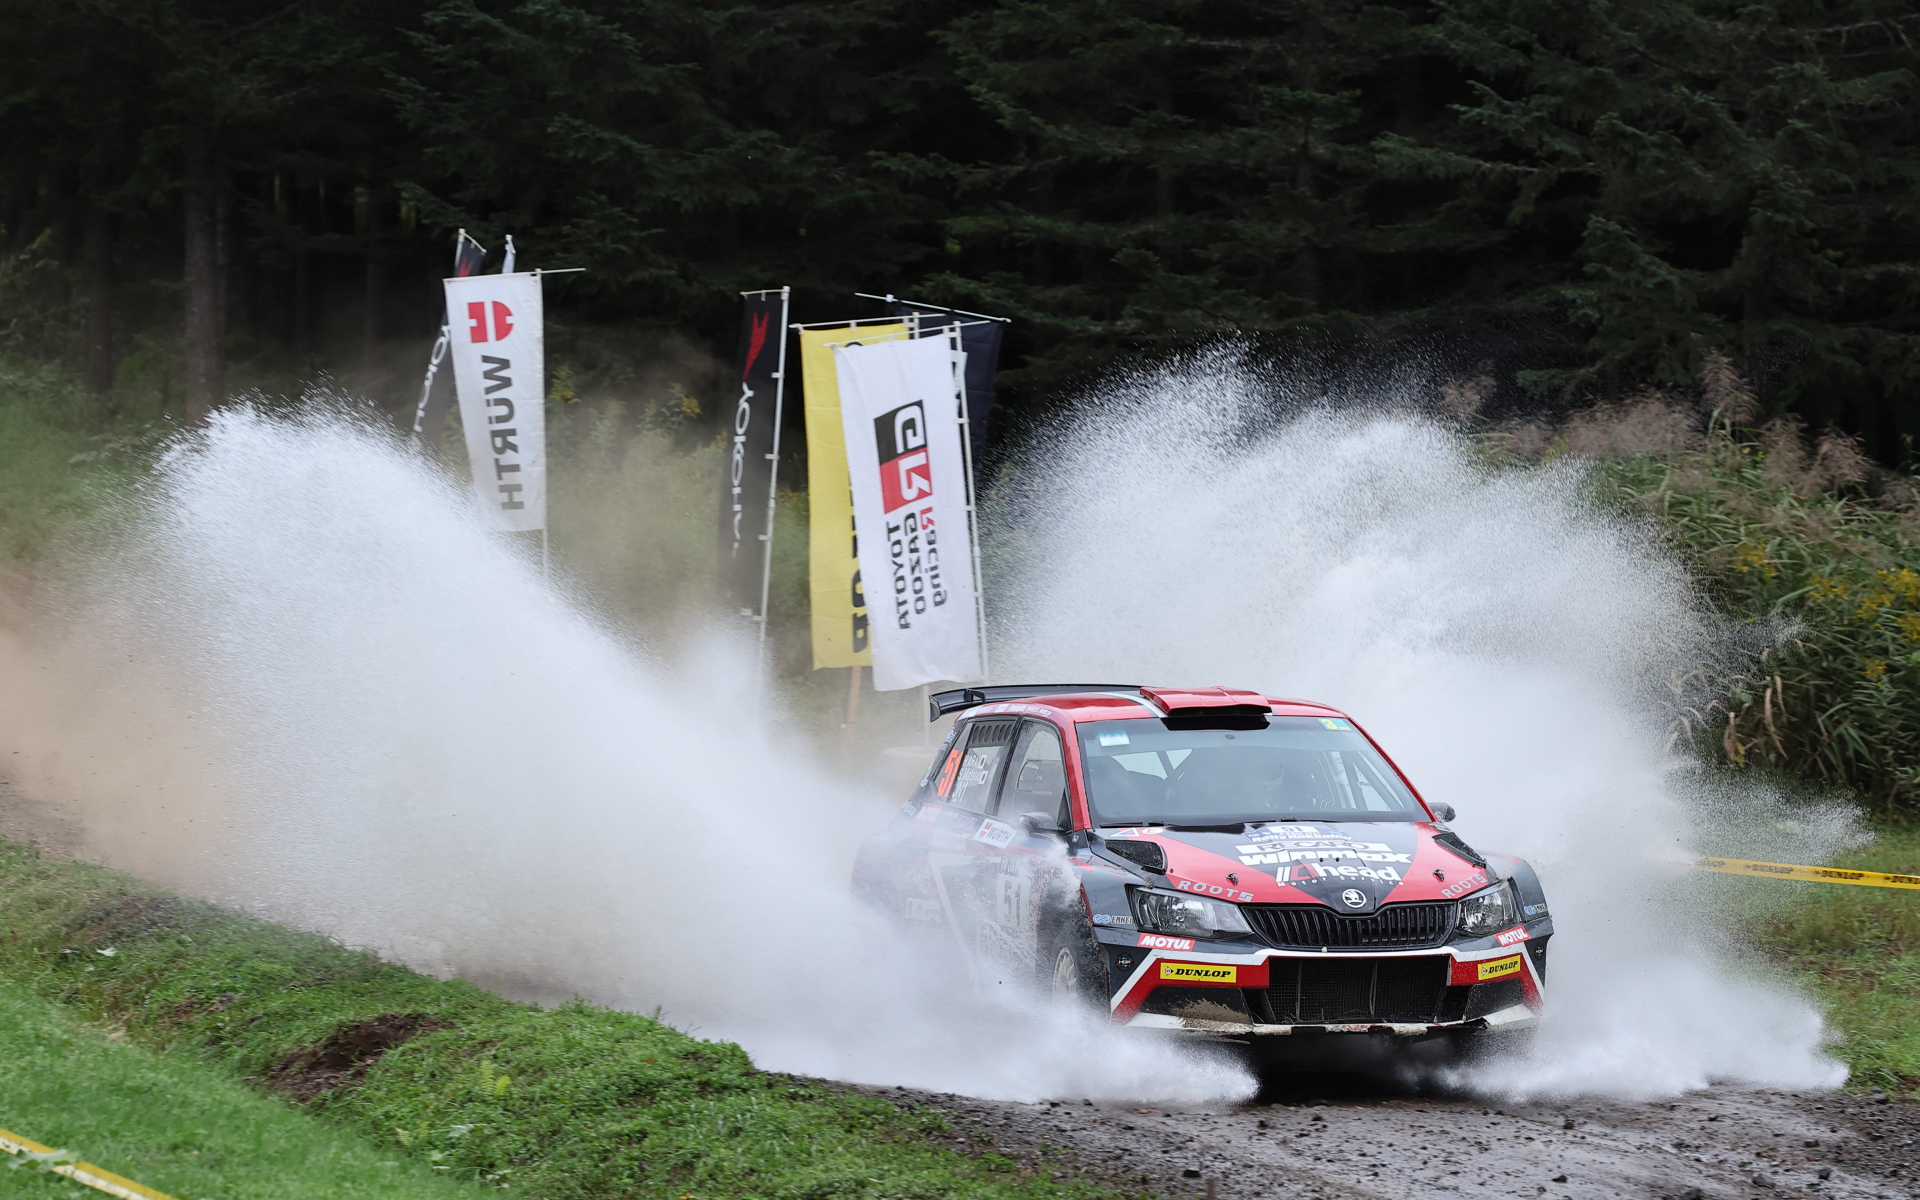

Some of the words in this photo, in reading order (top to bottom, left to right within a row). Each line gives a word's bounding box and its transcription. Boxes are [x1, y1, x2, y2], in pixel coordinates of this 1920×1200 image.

[937, 749, 965, 797] 51
[1237, 850, 1413, 866] winmax
[1278, 877, 1327, 887] Motor
[1340, 875, 1404, 886] Service
[1177, 880, 1254, 902] ROOTS
[1140, 936, 1191, 950] MOTUL
[1497, 928, 1528, 945] MOTUL
[1174, 968, 1231, 978] DUNLOP
[1488, 960, 1518, 974] DUNLOP
